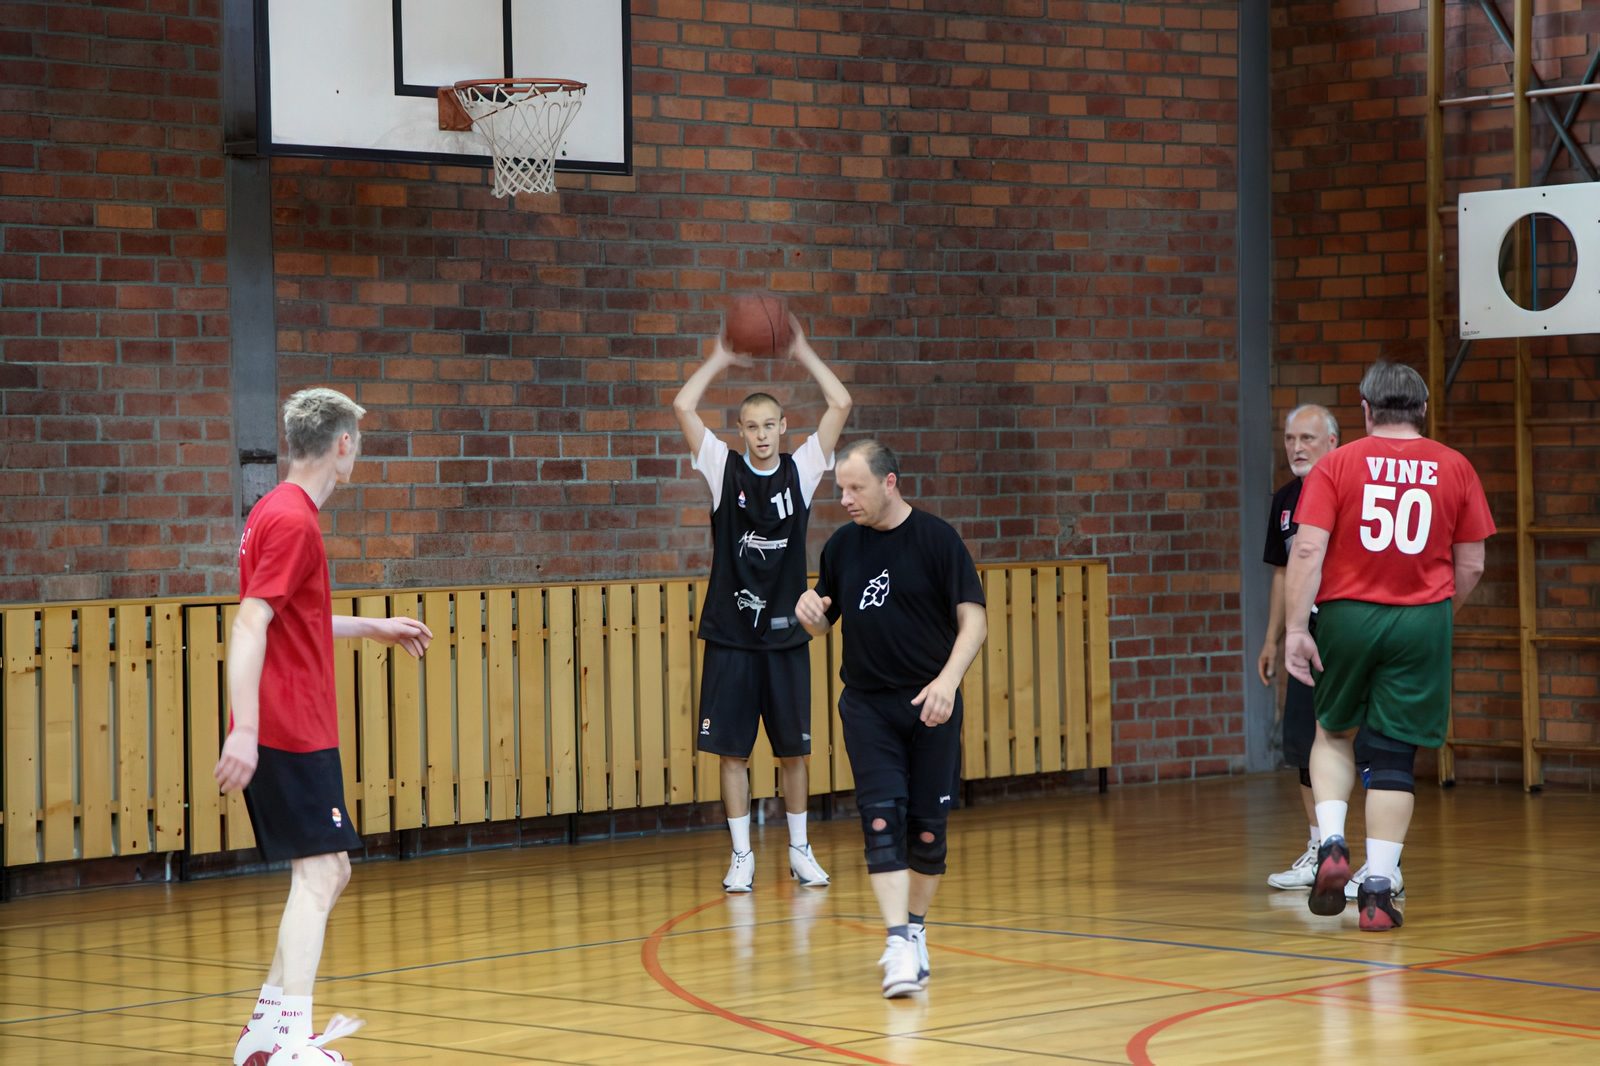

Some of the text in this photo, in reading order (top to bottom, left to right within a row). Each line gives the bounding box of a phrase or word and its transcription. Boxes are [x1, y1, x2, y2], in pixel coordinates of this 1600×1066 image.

[1366, 457, 1438, 485] VINE
[771, 487, 794, 520] 11
[1360, 484, 1432, 554] 50
